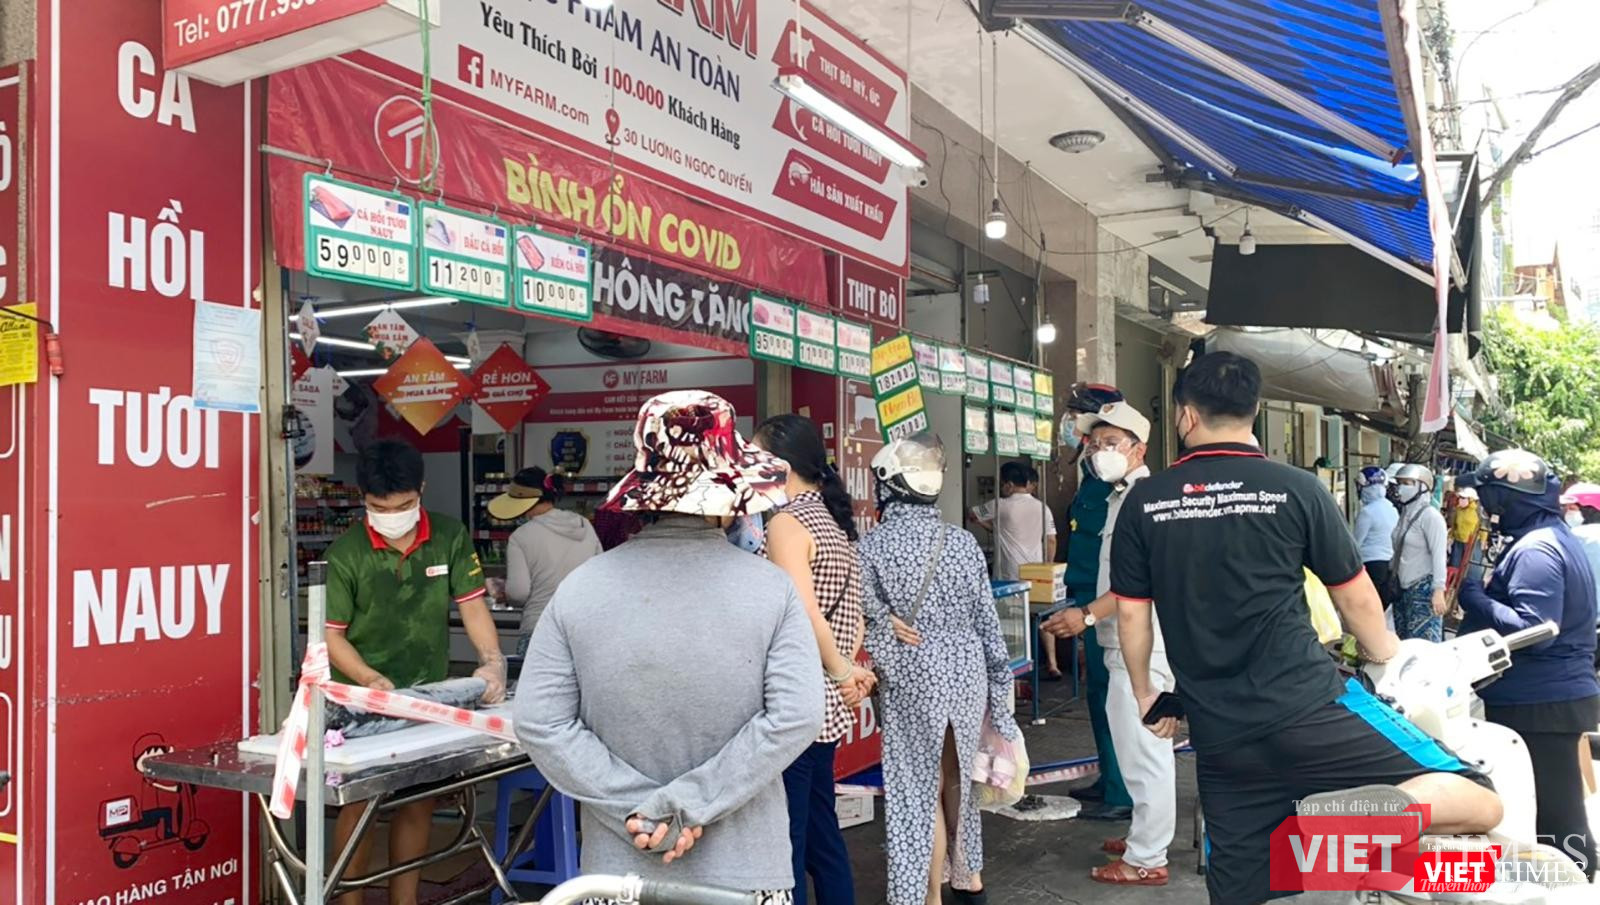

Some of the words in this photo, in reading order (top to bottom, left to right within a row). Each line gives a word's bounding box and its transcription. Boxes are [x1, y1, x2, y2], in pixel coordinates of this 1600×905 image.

[174, 14, 210, 46] Tel:
[480, 1, 513, 39] Yêu
[519, 21, 566, 64] Thích
[572, 48, 597, 79] Bởi
[604, 65, 664, 110] 100.000
[668, 95, 707, 131] Khách
[711, 116, 740, 150] Hàng
[649, 29, 681, 73] AN
[687, 47, 740, 102] TOÀN
[819, 56, 838, 80] THỊT
[840, 69, 851, 89] BÒ
[489, 68, 590, 126] MYFARM.com
[624, 127, 638, 146] 30
[641, 133, 682, 164] LƯƠNG
[684, 153, 716, 180] NGỌC
[504, 153, 595, 228] BÌNH
[602, 174, 652, 245] ỔN
[659, 213, 742, 270] COVID
[810, 176, 824, 198] HẢI
[826, 184, 843, 206] SẢN
[108, 199, 205, 301] HỒI
[593, 257, 686, 322] HÔNG
[847, 278, 876, 318] THỊT
[879, 286, 897, 321] BÒ
[403, 373, 421, 385] AN
[623, 370, 639, 385] MY
[640, 369, 668, 385] FARM
[1144, 498, 1181, 514] Maximum
[1182, 494, 1216, 511] Security
[1217, 492, 1258, 505] Maximum
[1258, 490, 1288, 503] Speed
[73, 563, 231, 648] NAUY
[115, 880, 168, 903] HÀNG
[172, 868, 206, 890] TẬN
[210, 857, 239, 879] NƠI
